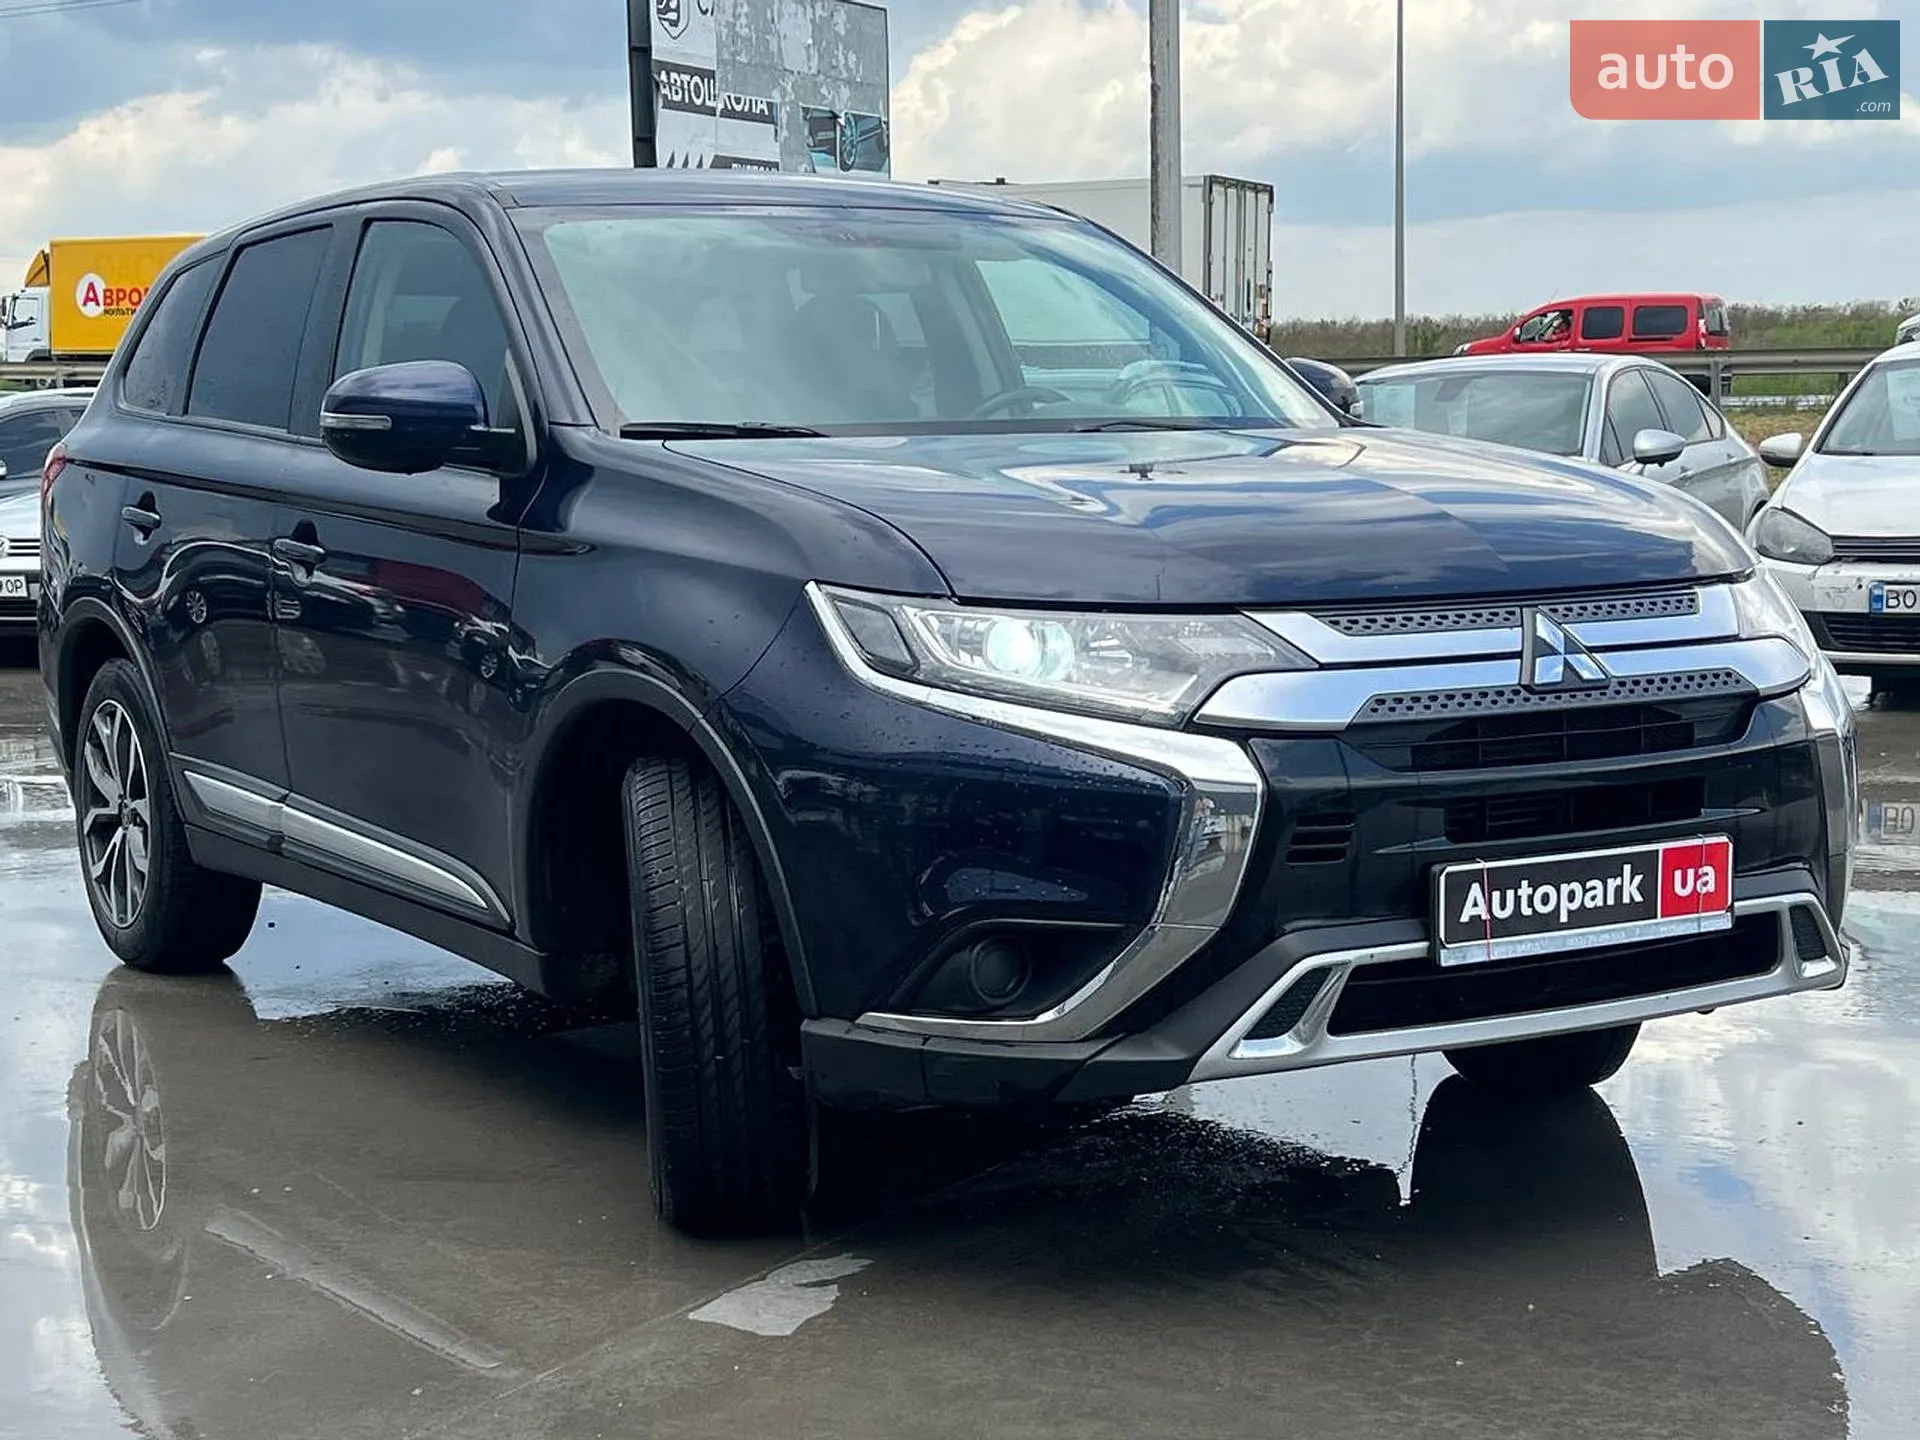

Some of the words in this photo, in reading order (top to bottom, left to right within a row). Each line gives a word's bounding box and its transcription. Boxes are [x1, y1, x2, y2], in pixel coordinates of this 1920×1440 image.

[1885, 589, 1918, 609] BO
[1459, 863, 1644, 923] Autopark
[1673, 863, 1716, 898] ua
